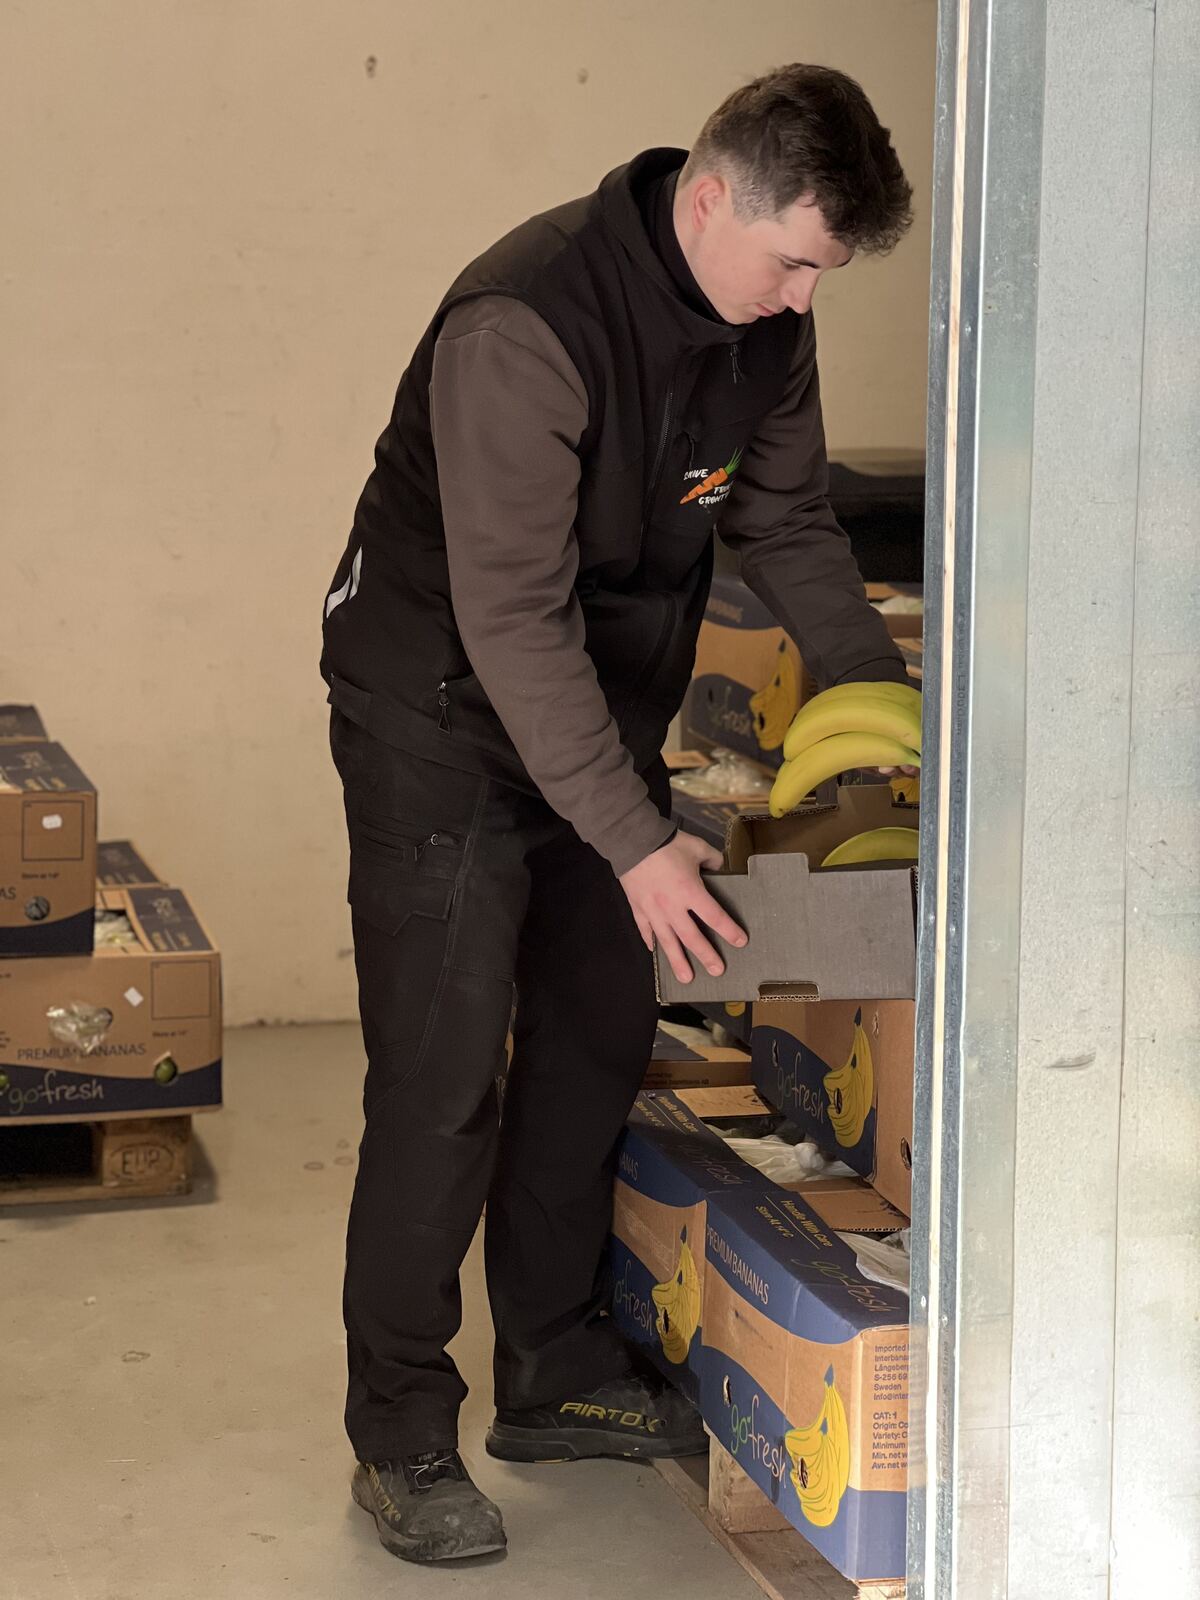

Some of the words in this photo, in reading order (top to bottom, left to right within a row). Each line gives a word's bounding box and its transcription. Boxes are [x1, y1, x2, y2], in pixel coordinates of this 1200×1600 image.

[780, 1200, 806, 1220] Handle
[801, 1219, 820, 1234] With
[814, 1232, 833, 1247] Care
[613, 1259, 653, 1335] ofresh
[875, 1344, 906, 1353] Imported
[873, 1383, 902, 1391] Sweden
[873, 1412, 892, 1420] CAT:
[873, 1422, 897, 1431] Origin:
[873, 1432, 901, 1441] Variety:
[872, 1441, 906, 1450] Minimum
[872, 1451, 888, 1460] Min.
[888, 1451, 901, 1459] net
[871, 1461, 887, 1470] Avr.
[887, 1461, 900, 1469] net
